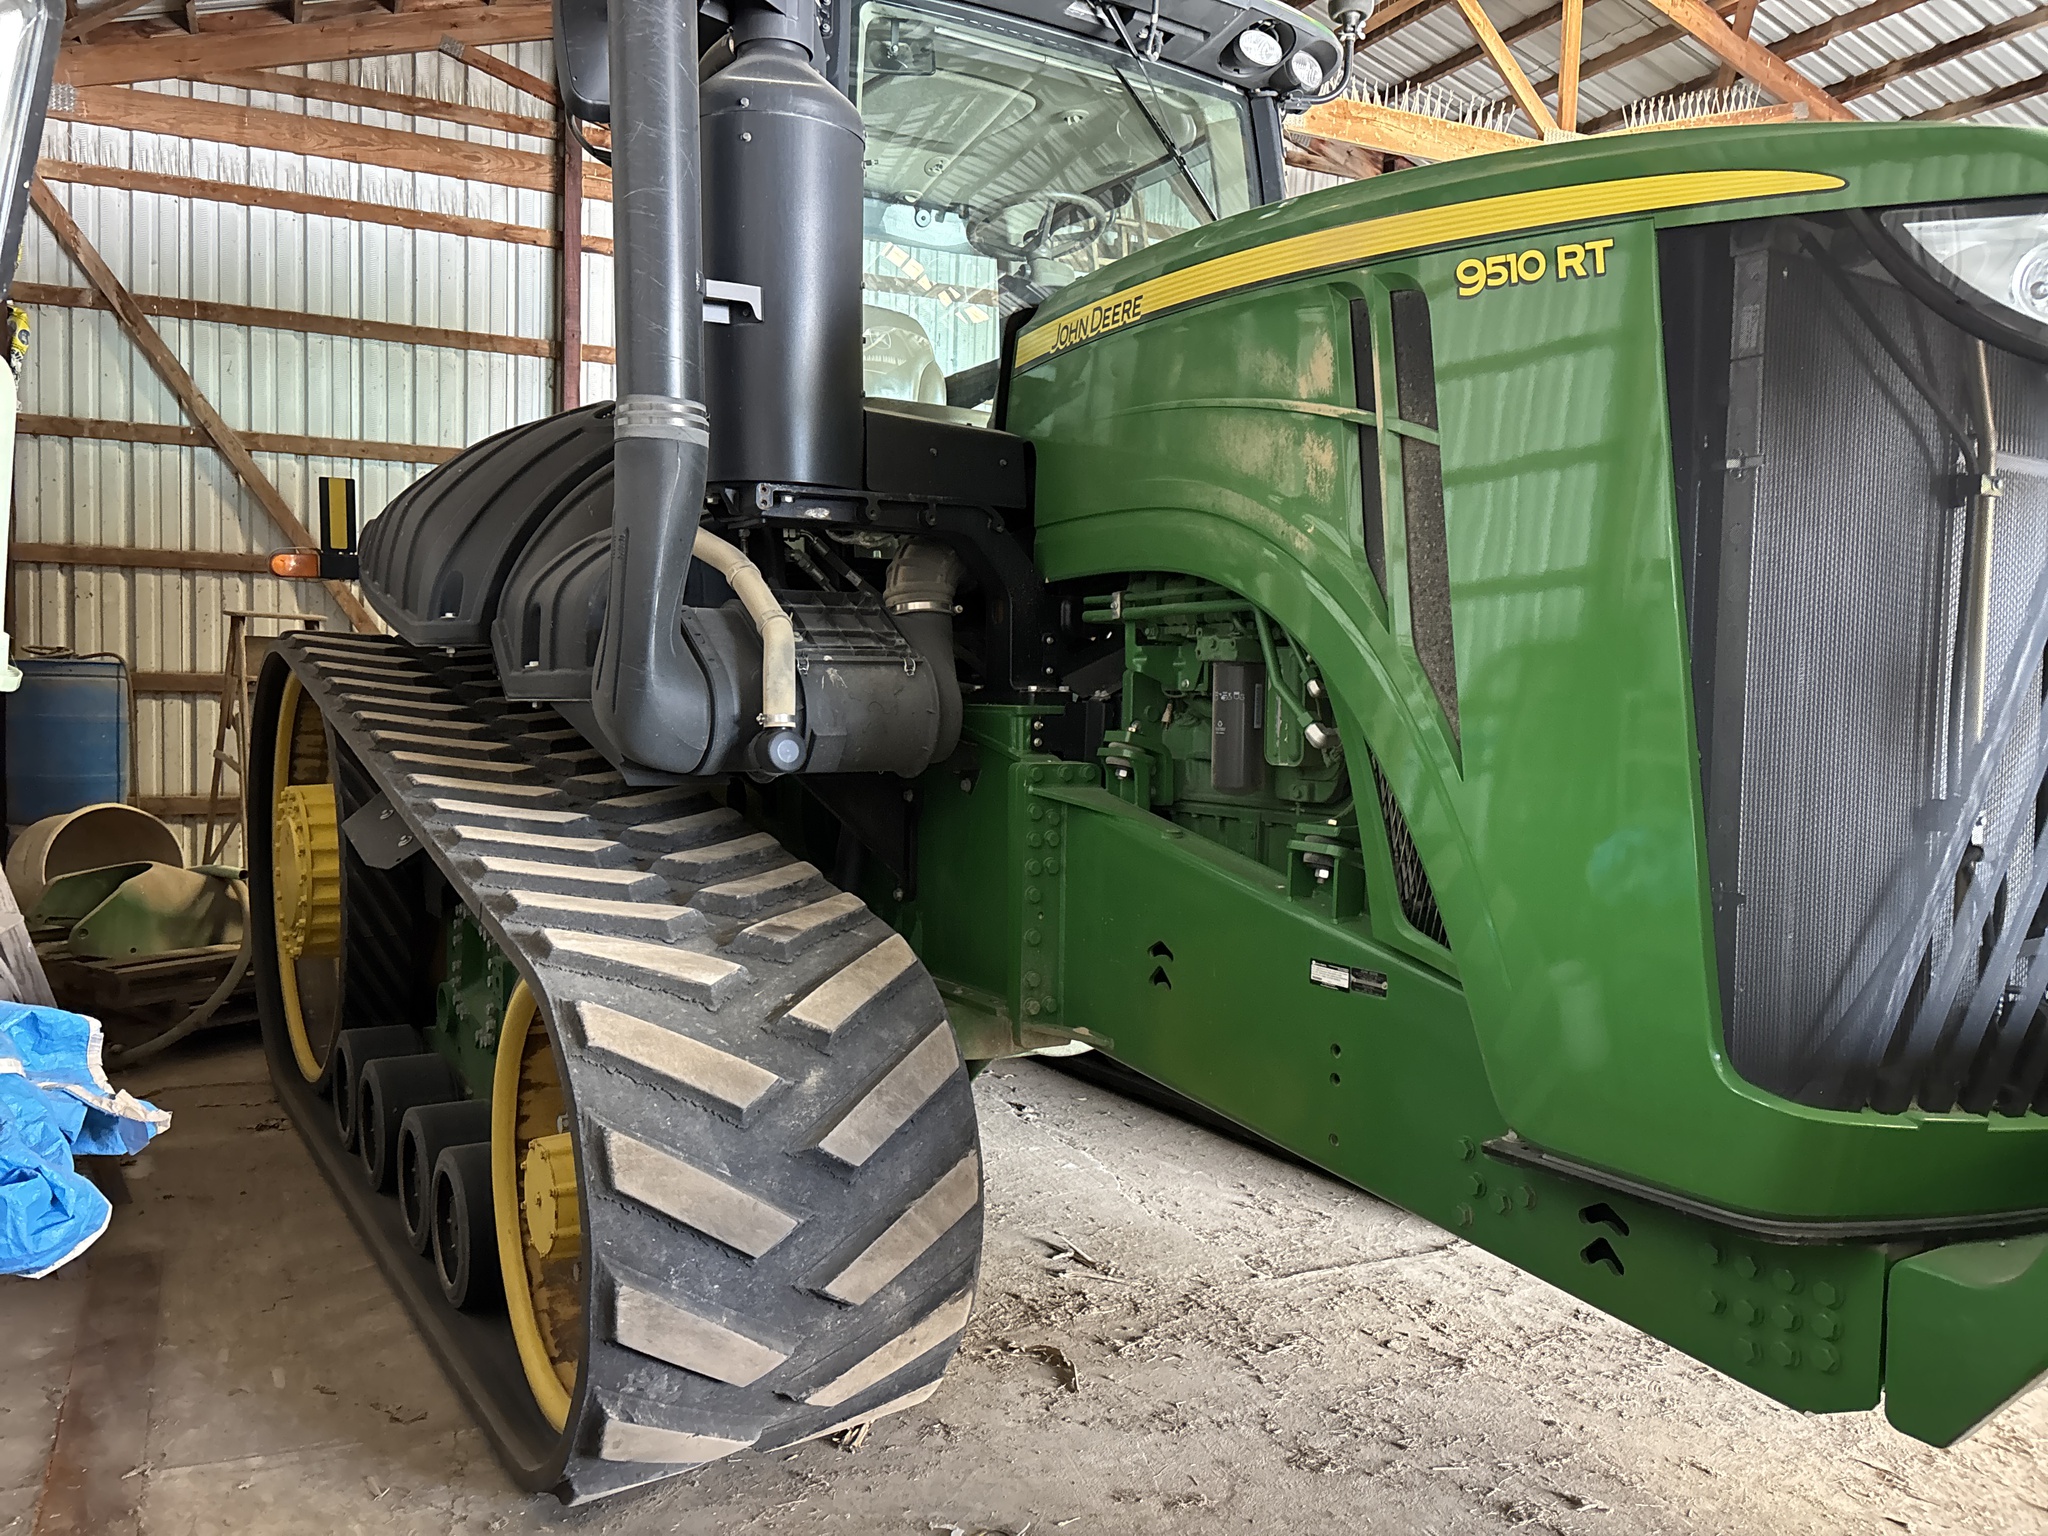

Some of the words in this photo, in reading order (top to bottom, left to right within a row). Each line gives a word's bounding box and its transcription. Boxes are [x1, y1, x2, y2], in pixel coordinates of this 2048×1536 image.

[1455, 249, 1547, 299] 9510
[1556, 237, 1615, 283] RT
[1050, 315, 1090, 351] JOHN
[1090, 294, 1144, 334] DEERE
